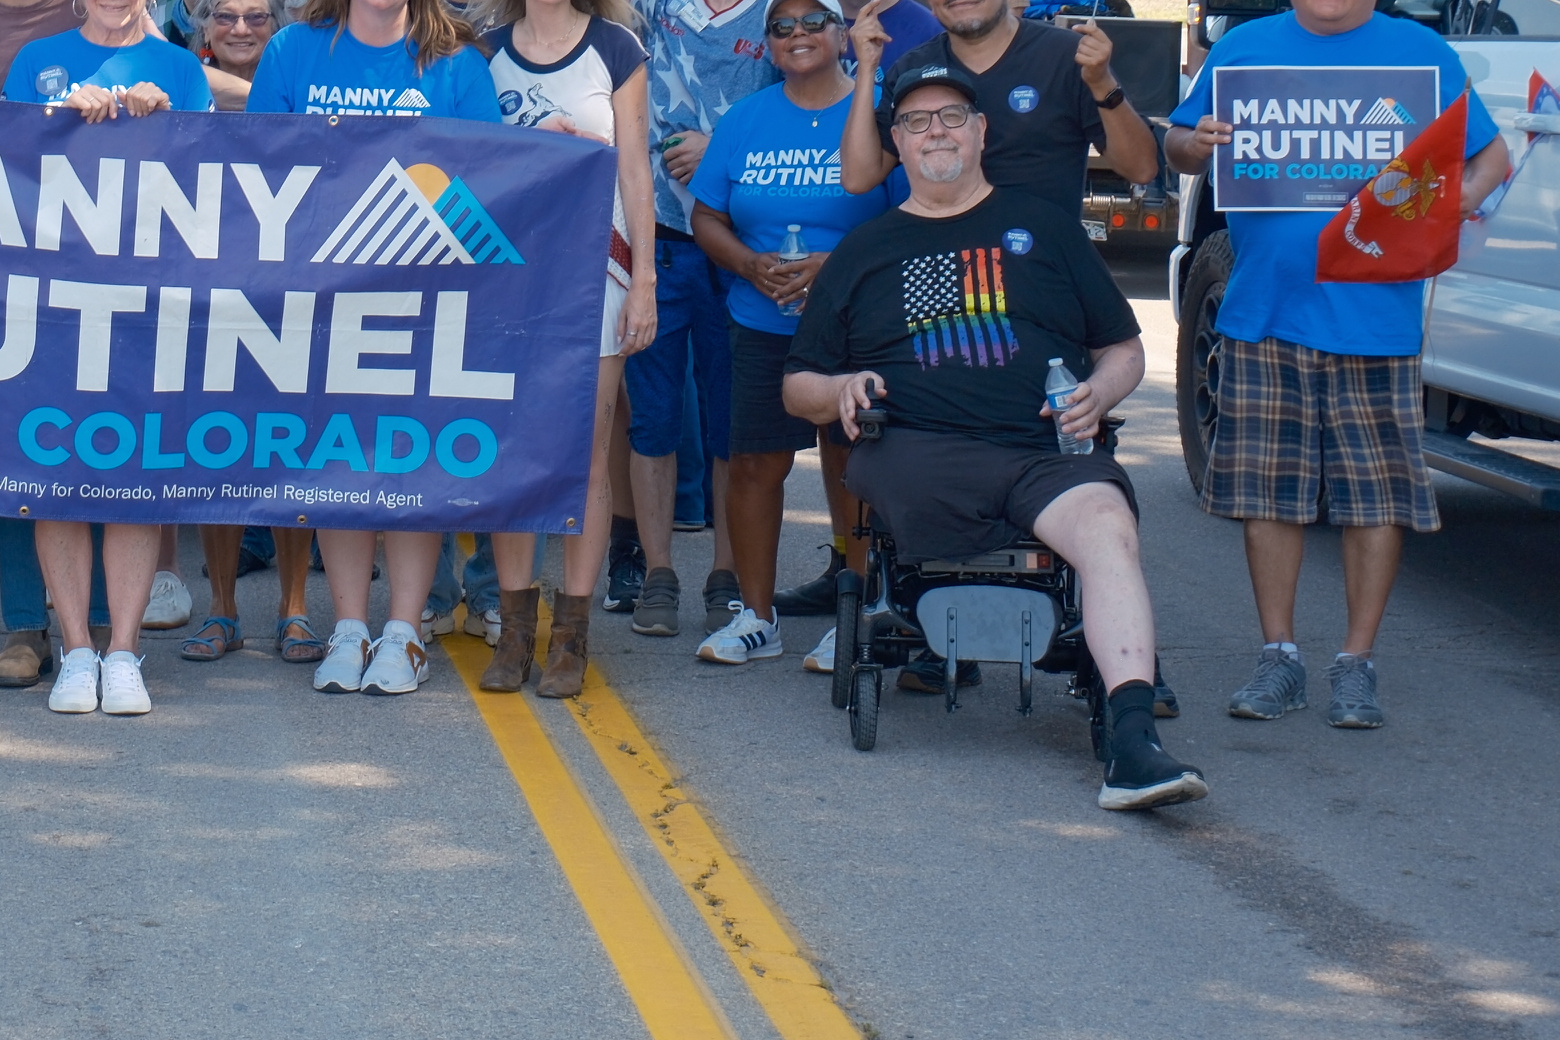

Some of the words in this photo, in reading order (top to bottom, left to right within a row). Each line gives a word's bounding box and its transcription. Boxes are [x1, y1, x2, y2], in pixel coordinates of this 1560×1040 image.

[308, 84, 395, 108] MANNY
[1233, 98, 1362, 125] MANNY
[745, 149, 827, 168] MANNY
[739, 167, 842, 185] RUTINE
[1234, 163, 1279, 180] FOR
[1286, 163, 1390, 180] COLORA
[738, 186, 762, 196] FOR
[1350, 200, 1362, 225] ARINE
[18, 405, 499, 479] COLORADO
[51, 481, 74, 498] for
[79, 483, 157, 502] Colorado,
[162, 483, 216, 501] Manny
[221, 482, 278, 499] Rutinel
[283, 485, 370, 506] Registered
[375, 489, 424, 508] Agent
